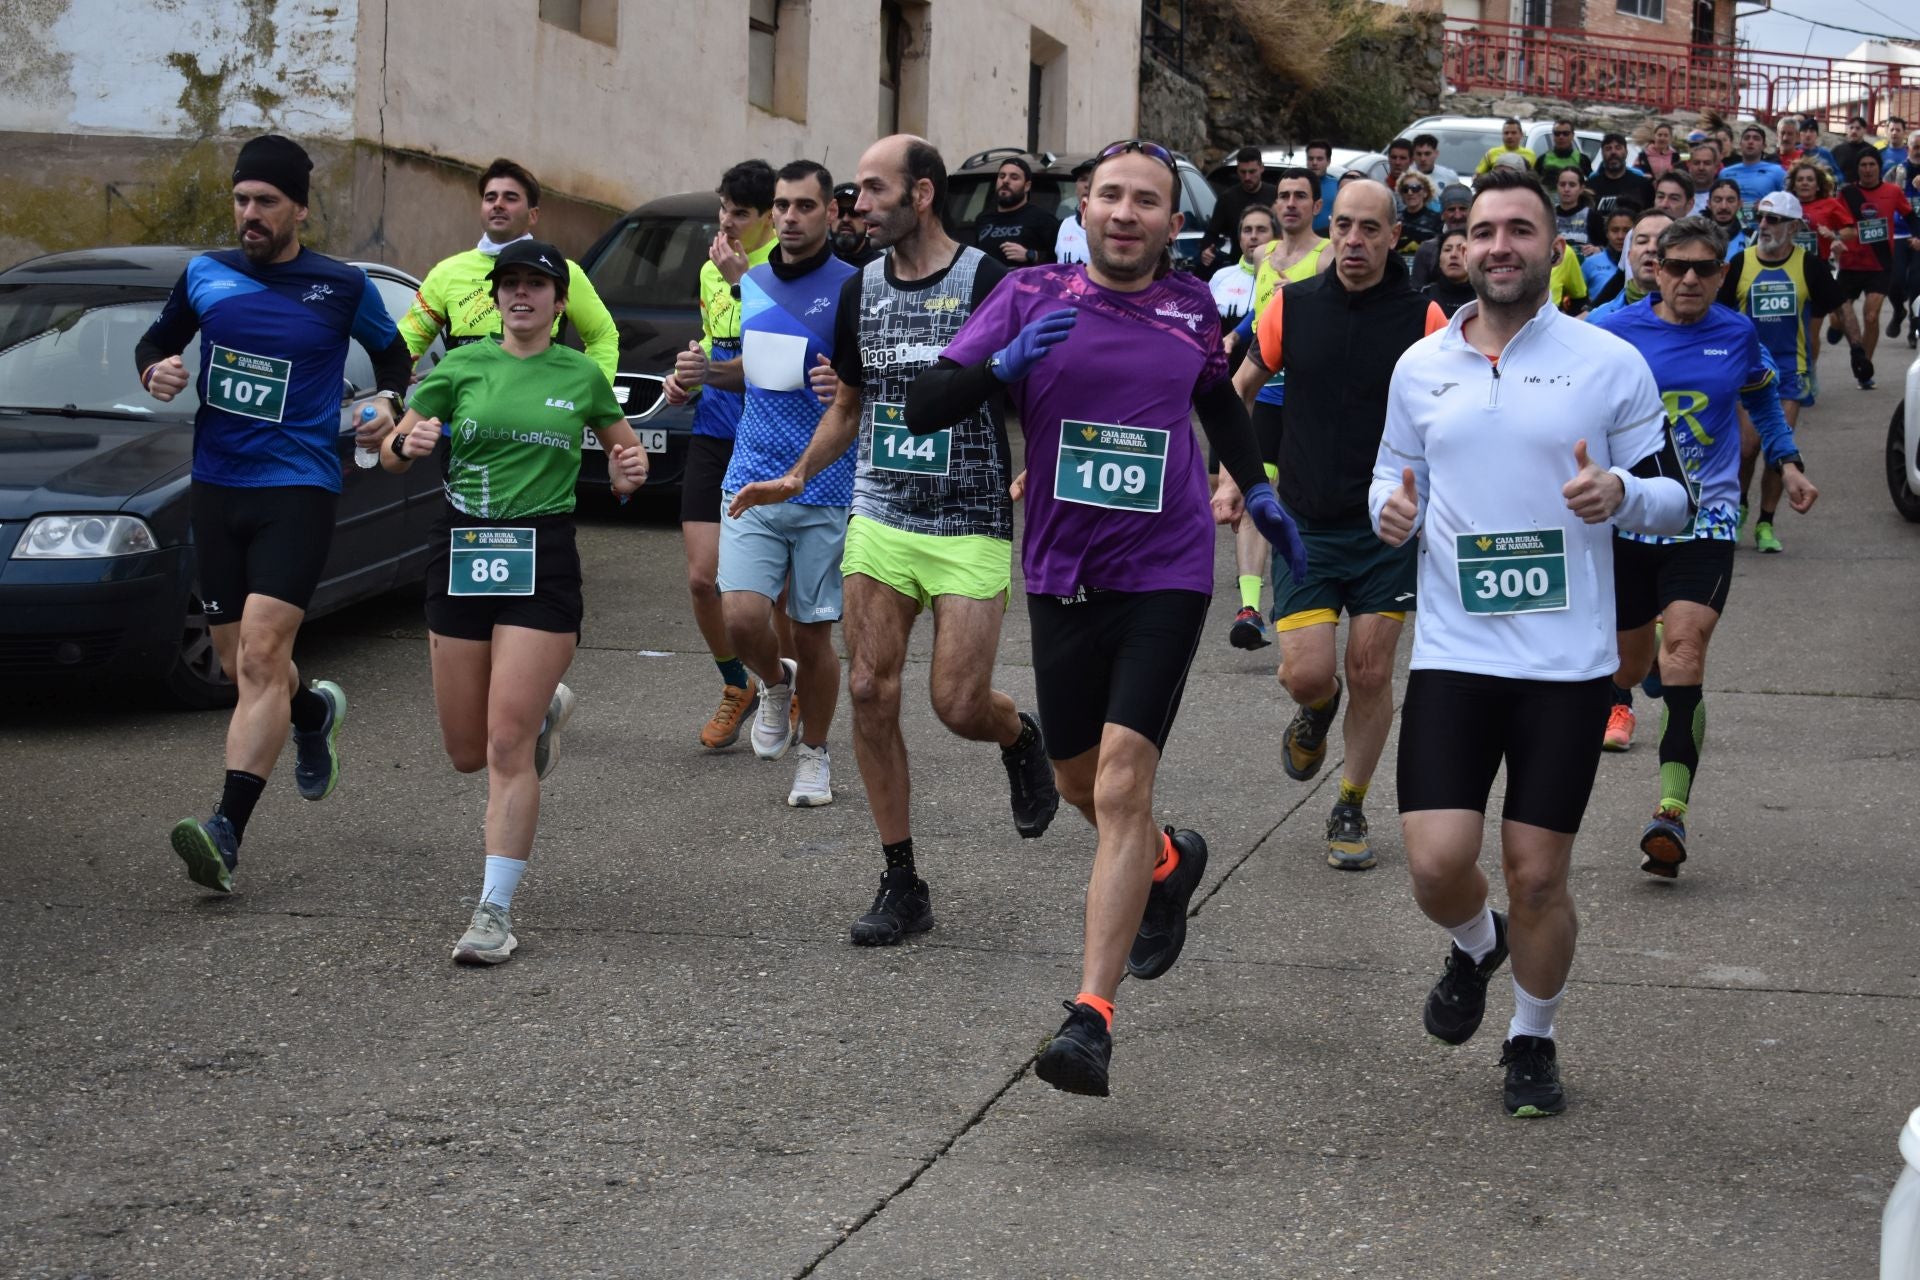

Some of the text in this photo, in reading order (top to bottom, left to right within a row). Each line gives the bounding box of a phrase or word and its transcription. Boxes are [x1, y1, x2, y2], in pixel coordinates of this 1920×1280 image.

[991, 225, 1023, 238] asics
[458, 286, 484, 308] RINCON
[1759, 296, 1790, 311] 206
[469, 304, 496, 329] ATLETISM
[238, 360, 273, 373] DE NAVARRA
[220, 377, 272, 406] 107
[545, 398, 574, 411] LEA
[480, 427, 510, 440] club
[512, 430, 570, 450] LaBlanca
[1113, 438, 1148, 448] NAVARRA
[1120, 432, 1145, 441] RURAL
[883, 434, 936, 461] 144
[1076, 460, 1146, 494] 109
[1495, 535, 1541, 545] CAJA RURAL
[1495, 542, 1545, 551] DE NAVARRA
[471, 558, 510, 583] 86
[1475, 567, 1549, 599] 300
